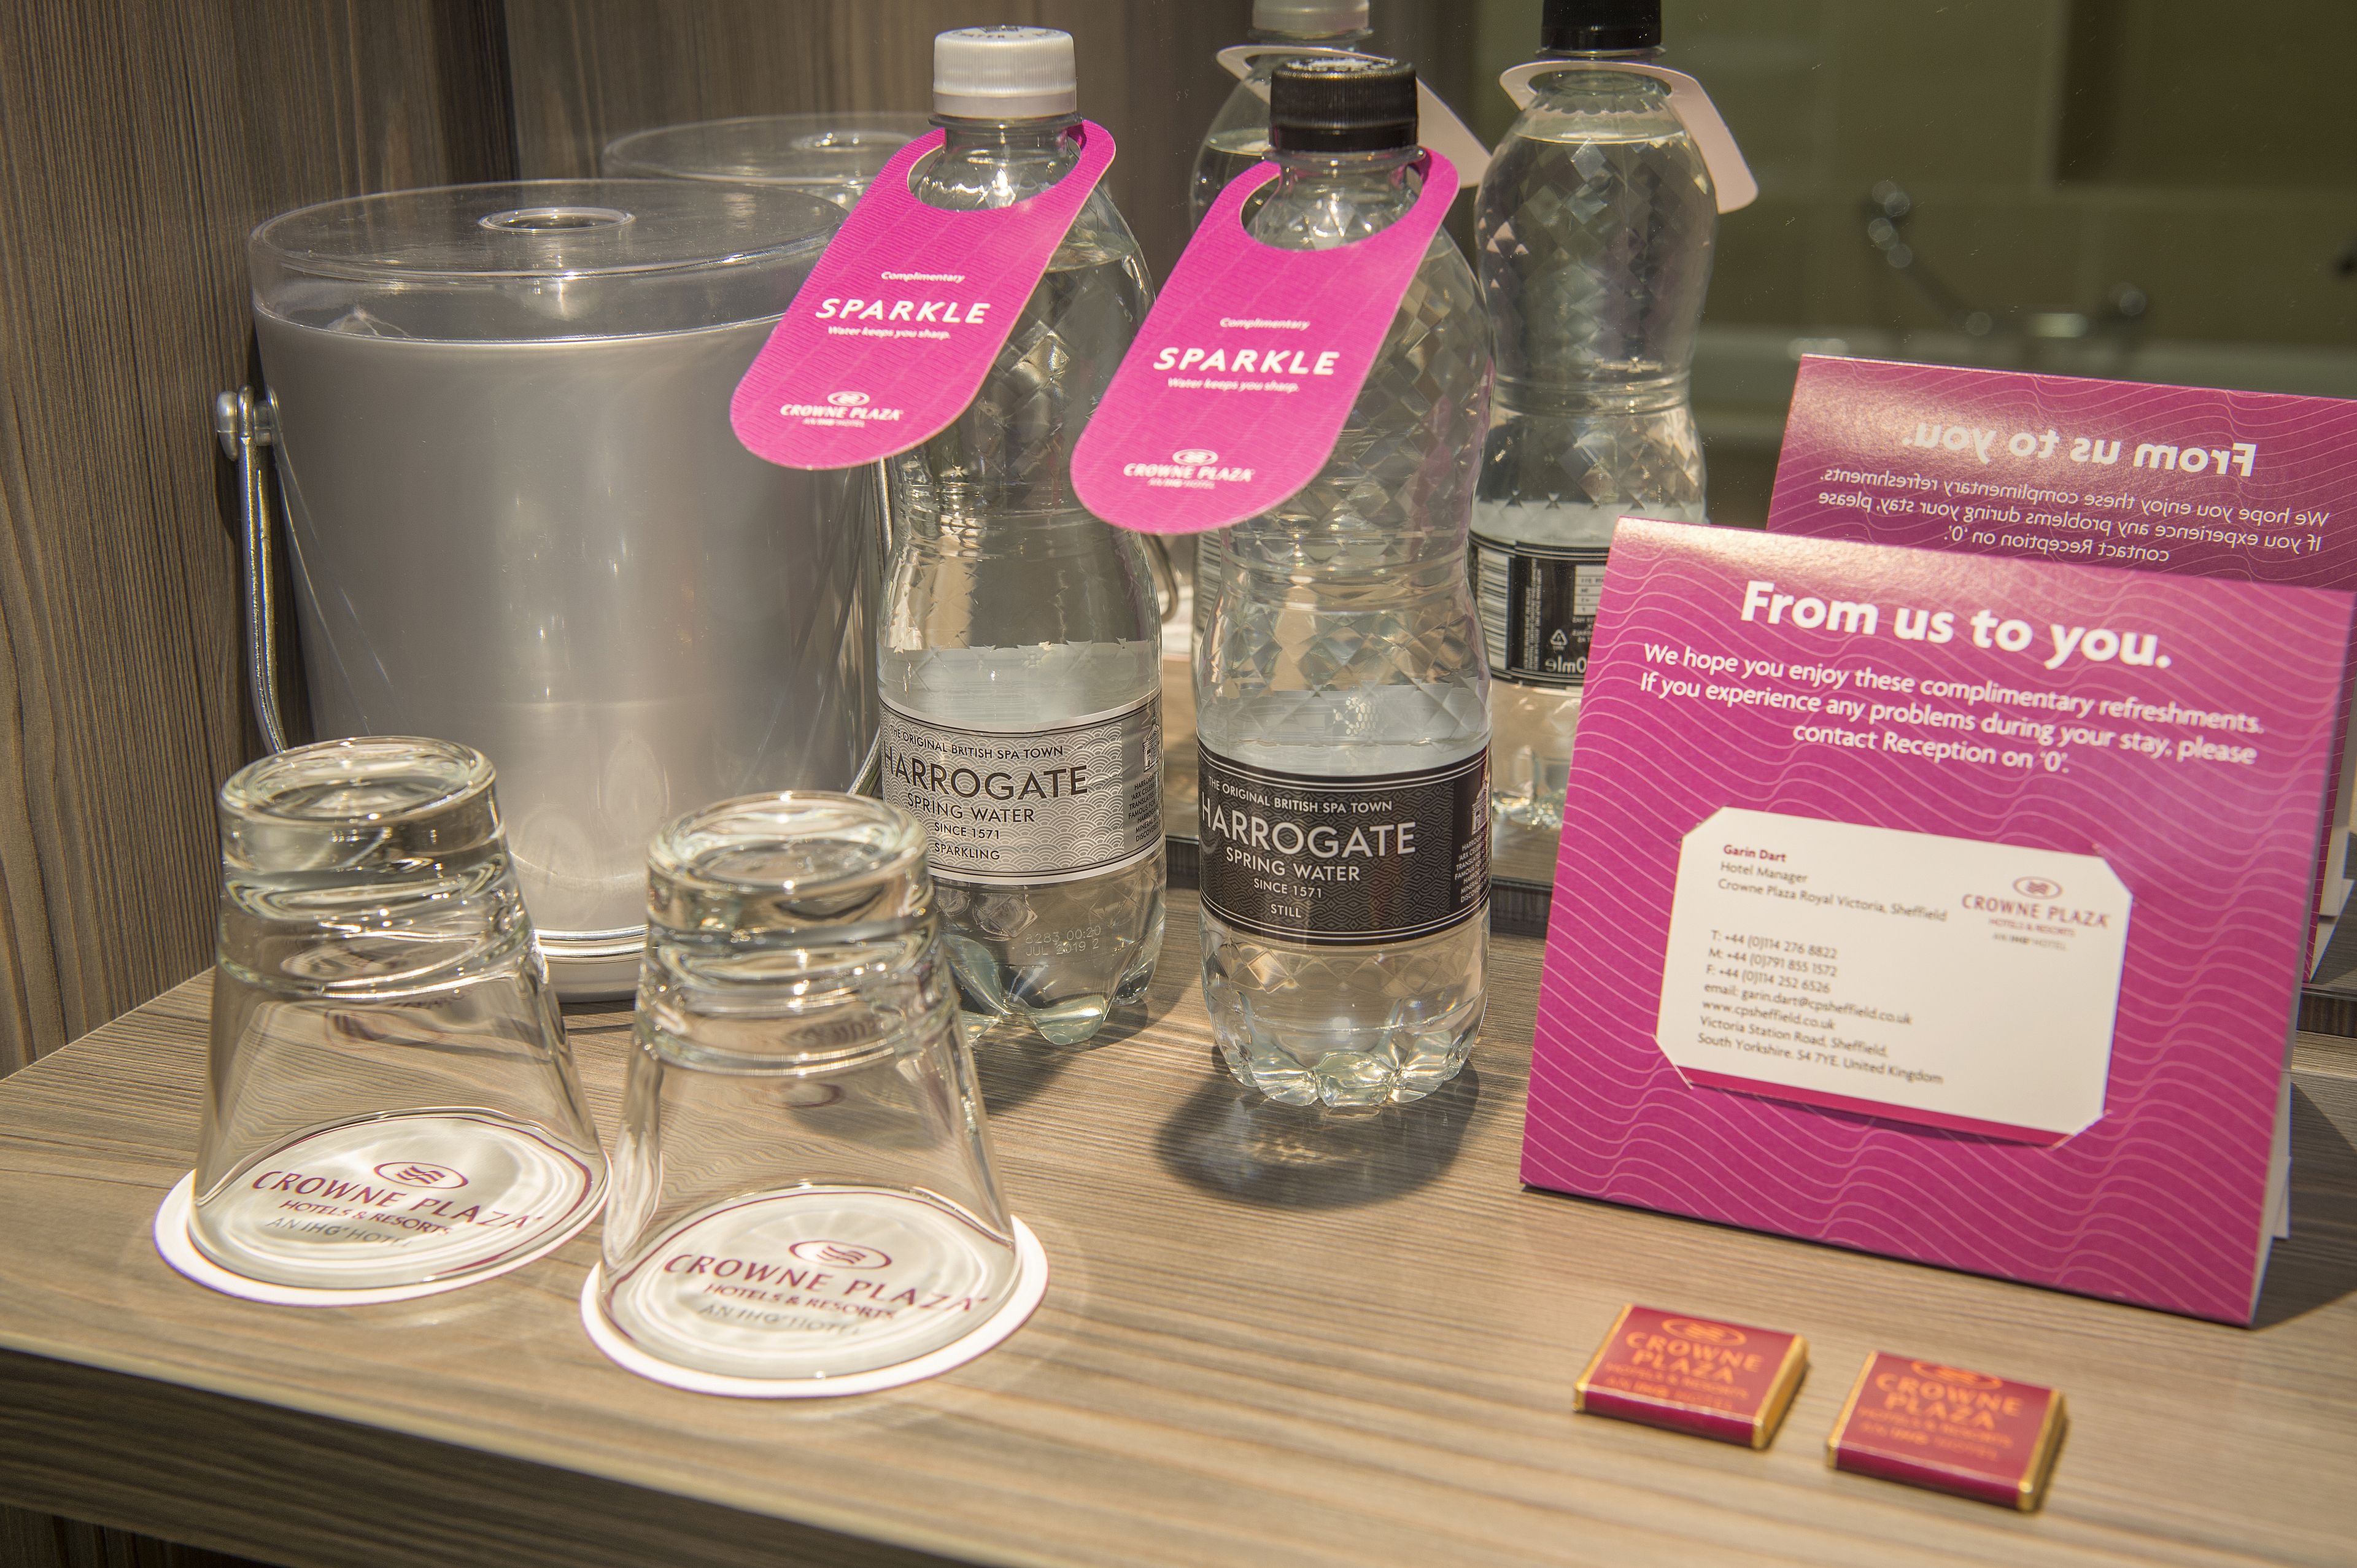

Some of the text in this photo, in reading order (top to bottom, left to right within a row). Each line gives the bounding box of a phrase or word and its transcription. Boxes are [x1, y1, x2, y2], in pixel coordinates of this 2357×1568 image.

[881, 271, 965, 283] Complimentary
[815, 298, 991, 323] SPARKLE
[1220, 317, 1310, 331] Complimentary
[829, 326, 859, 336] Water
[861, 327, 894, 338] keeps
[894, 330, 917, 339] you
[1153, 347, 1340, 375] SPARKLE
[1167, 377, 1203, 388] Water
[1204, 378, 1239, 392] keeps
[1239, 381, 1264, 392] you
[780, 404, 900, 421] CROWNE PLAZA
[1123, 463, 1252, 482] CROWNE PLAZA
[1741, 580, 2172, 670] From us to you.
[1644, 643, 2264, 733] We hope you enjoy these complimentary refreshments.
[1640, 671, 1659, 692] If
[1658, 679, 1701, 699] you
[1705, 684, 1822, 708] experience
[1825, 697, 1865, 722] any
[1869, 702, 1976, 731] problems
[1981, 711, 2056, 746] during
[2057, 726, 2116, 747] your
[2177, 735, 2258, 764] please
[890, 725, 1063, 759] THE ORIGINAL BRITISH SPA TOWN
[1792, 725, 1878, 750] contact
[1883, 732, 1997, 763] Reception
[2001, 751, 2034, 768] on
[884, 741, 1088, 800] HARROGATE
[907, 793, 1035, 823] SPRING WATER
[1208, 776, 1393, 813] THE ORIGINAL BRITISH SPA TOWN
[934, 822, 1000, 840] SINCE 1571
[1202, 791, 1416, 858] HARROGATE
[934, 843, 1000, 860] SPARKLING
[1226, 846, 1360, 881] SPRING WATER
[1724, 844, 1786, 862] Garin Dart
[1720, 861, 1808, 884] Hotel Manager
[1254, 878, 1322, 898] SINCE 1571
[1718, 878, 1763, 894] Crowne
[1767, 886, 1797, 900] Plaza
[1800, 890, 1833, 906] Royal
[1891, 903, 1948, 922] Sheffield
[1271, 903, 1301, 918] STILL
[1962, 894, 2108, 928] CROWNE PLAZA
[1026, 925, 1101, 944] 8283 00:20
[1026, 938, 1099, 956] JUL 2019 2
[1711, 929, 1721, 941] T:
[1725, 934, 1745, 944] +44
[1784, 940, 1805, 954] 276
[1708, 948, 1724, 959] M:
[1727, 951, 1747, 962] +44
[1706, 964, 1716, 975] F:
[1719, 968, 1739, 979] +44
[1704, 983, 1740, 997] email:
[1700, 1016, 1746, 1034] Victoria
[1748, 1023, 1792, 1041] Station
[1697, 1032, 1733, 1049] South
[1843, 1057, 1886, 1075] United
[1887, 1065, 1944, 1086] Kingdom
[252, 1170, 532, 1229] CROWNE PLAZA
[266, 1217, 300, 1228] AN
[280, 1200, 452, 1236] HOTELS & RESORTS
[664, 1254, 971, 1313] CROWNE PLAZA
[704, 1283, 894, 1321] HOTELS & RESORTS
[1626, 1332, 1763, 1372] CROWNE
[1631, 1349, 1734, 1385] PLAZA
[1876, 1373, 2024, 1416] CROWNE
[1884, 1392, 1995, 1430] PLAZA
